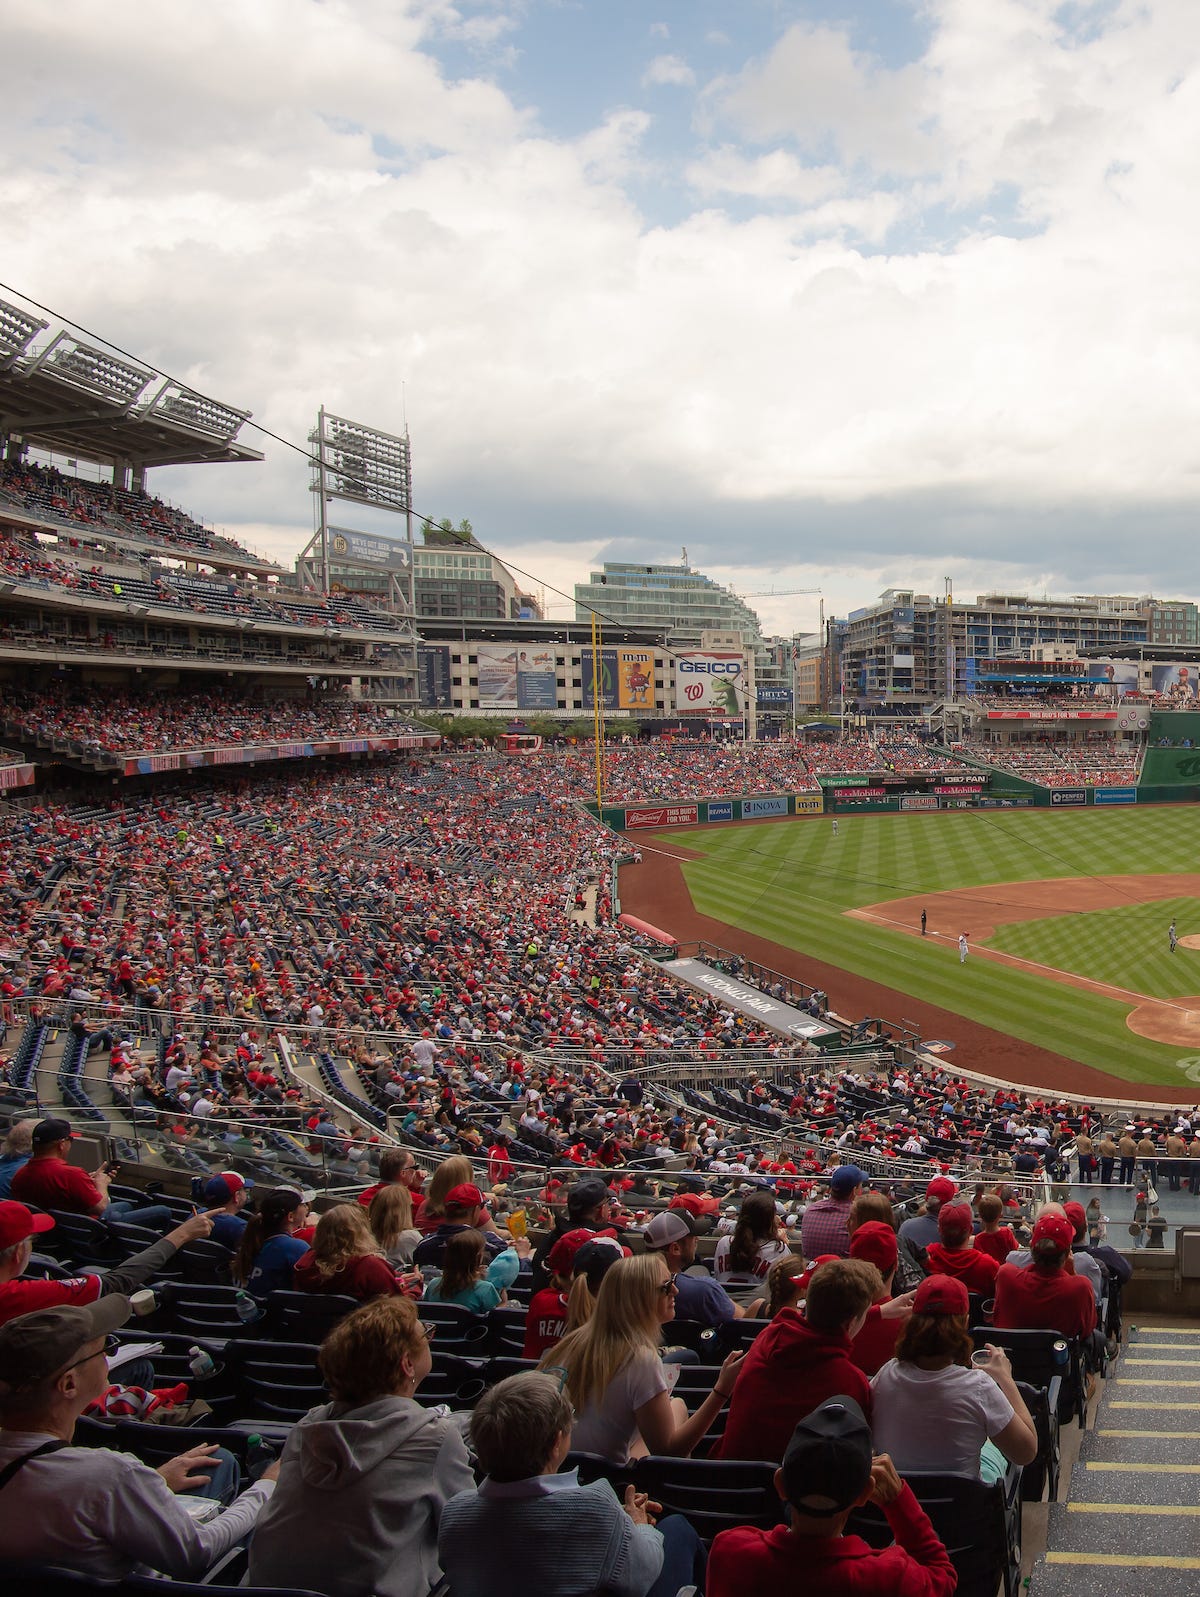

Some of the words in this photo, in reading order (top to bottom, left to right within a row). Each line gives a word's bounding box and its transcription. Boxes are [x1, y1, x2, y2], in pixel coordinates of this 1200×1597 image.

[679, 662, 741, 674] GEICO
[966, 775, 985, 783] FAN
[680, 807, 697, 815] BUD'S
[753, 802, 781, 812] INOVA
[696, 973, 751, 1004] NATIONALS
[744, 997, 780, 1014] PARK
